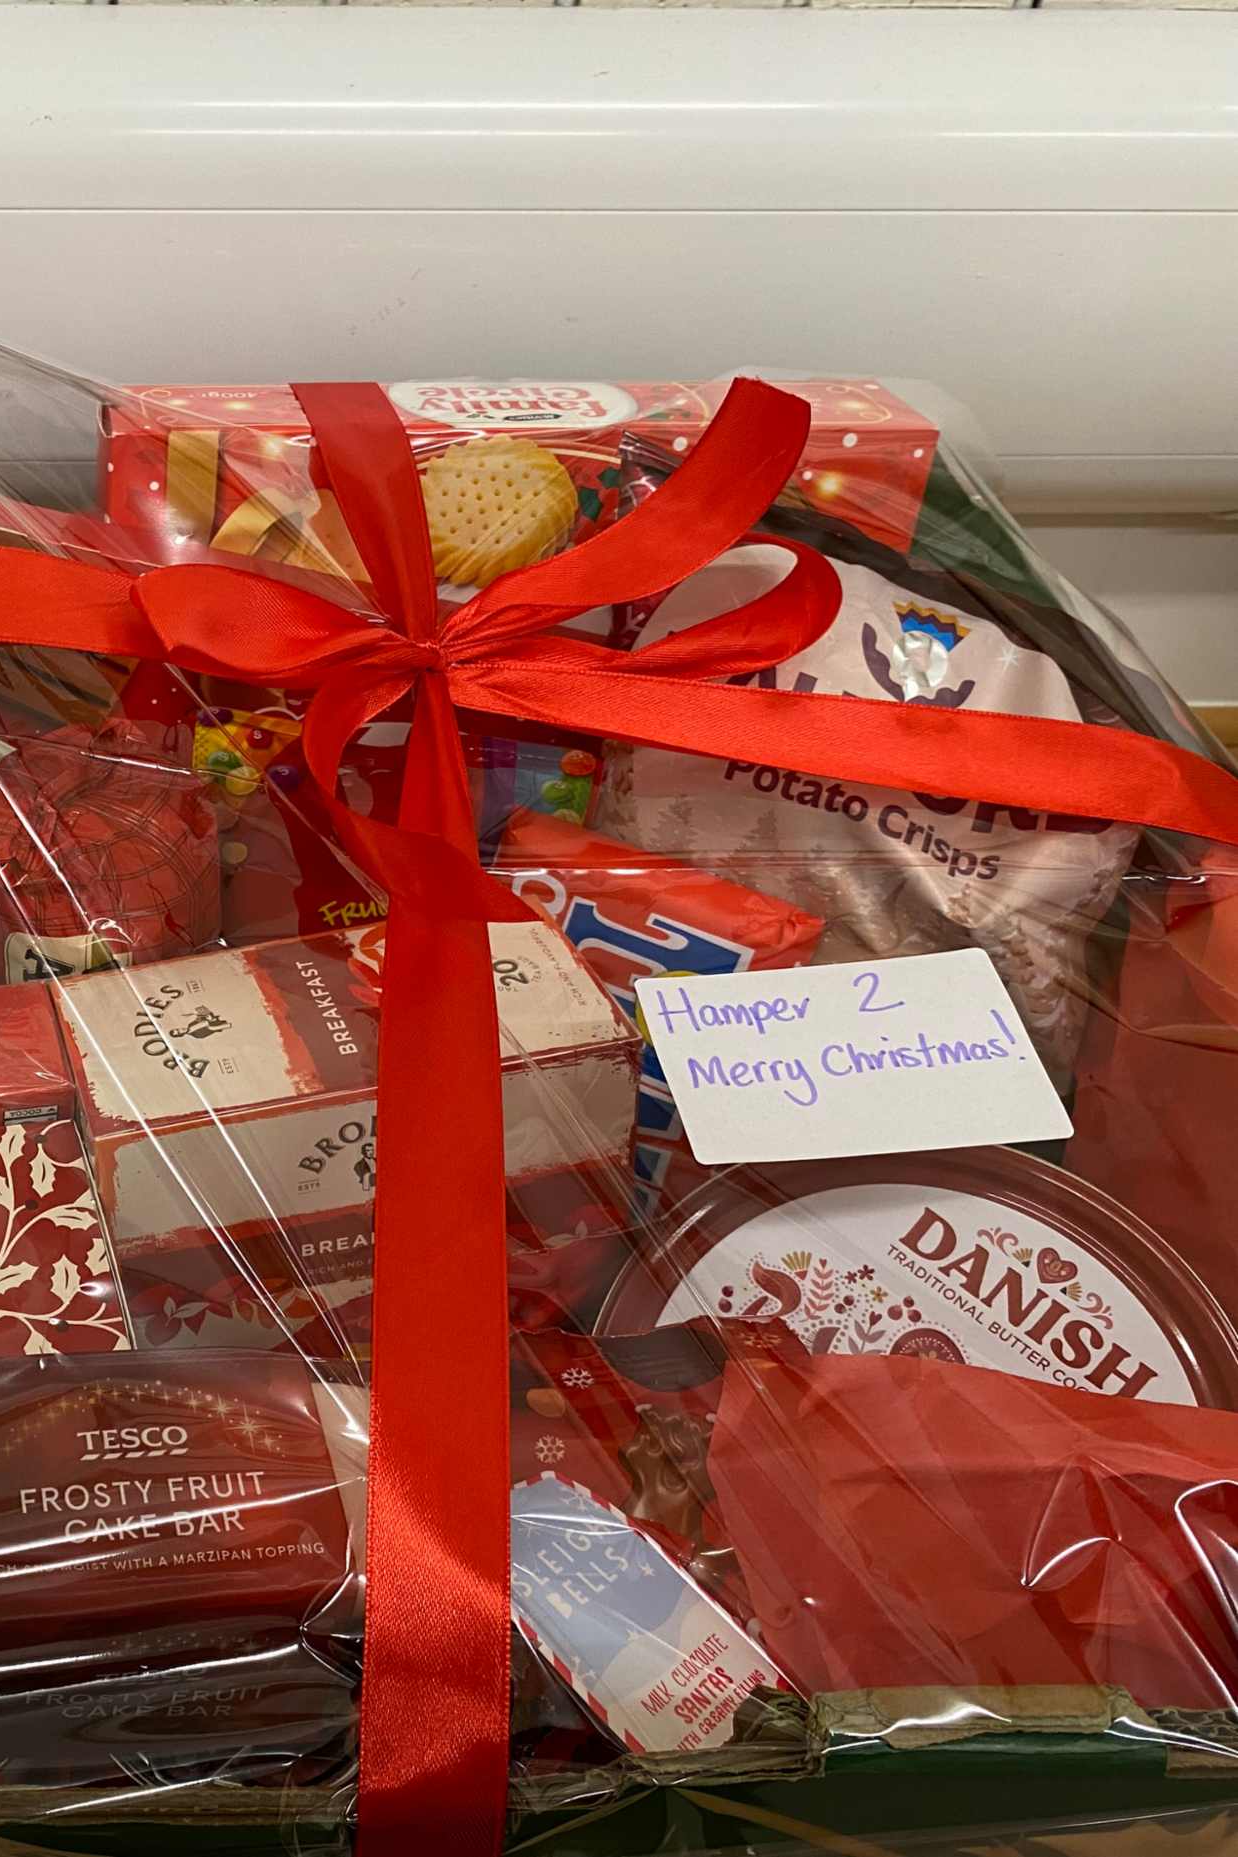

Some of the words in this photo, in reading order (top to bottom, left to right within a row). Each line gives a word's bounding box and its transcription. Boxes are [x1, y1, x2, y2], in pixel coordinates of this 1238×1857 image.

[723, 758, 870, 823] Potato
[877, 804, 1002, 881] Crisps
[492, 957, 529, 986] 20
[296, 961, 359, 1056] BREAKFAST
[657, 989, 810, 1035] Hamper
[852, 971, 905, 1014] 2
[687, 1056, 819, 1107] Merry
[821, 1007, 1027, 1079] Christmas!
[301, 1231, 376, 1258] BREA
[886, 1242, 985, 1327] TRADITIONAL
[988, 1319, 1052, 1373] BUTTER
[898, 1205, 1158, 1399] DANISH
[77, 1425, 188, 1454] TESCO
[19, 1479, 154, 1514] FROSTY
[167, 1471, 265, 1503] FRUIT
[64, 1514, 160, 1545] CAKE
[174, 1508, 246, 1538] BAR
[112, 1556, 154, 1572] WITH
[158, 1556, 169, 1566] A
[173, 1549, 252, 1565] MARZIPAN
[257, 1542, 325, 1557] TOPPING
[546, 1546, 630, 1620] BELLS
[25, 1690, 159, 1705] FROSTY
[169, 1687, 264, 1702] FRUIT
[641, 1679, 674, 1716] MILK
[670, 1633, 729, 1688] CHOCOLATE
[673, 1666, 734, 1725] SANTAS
[60, 1705, 156, 1719] CAKE
[166, 1703, 235, 1717] BAR
[698, 1694, 739, 1735] CREAMY
